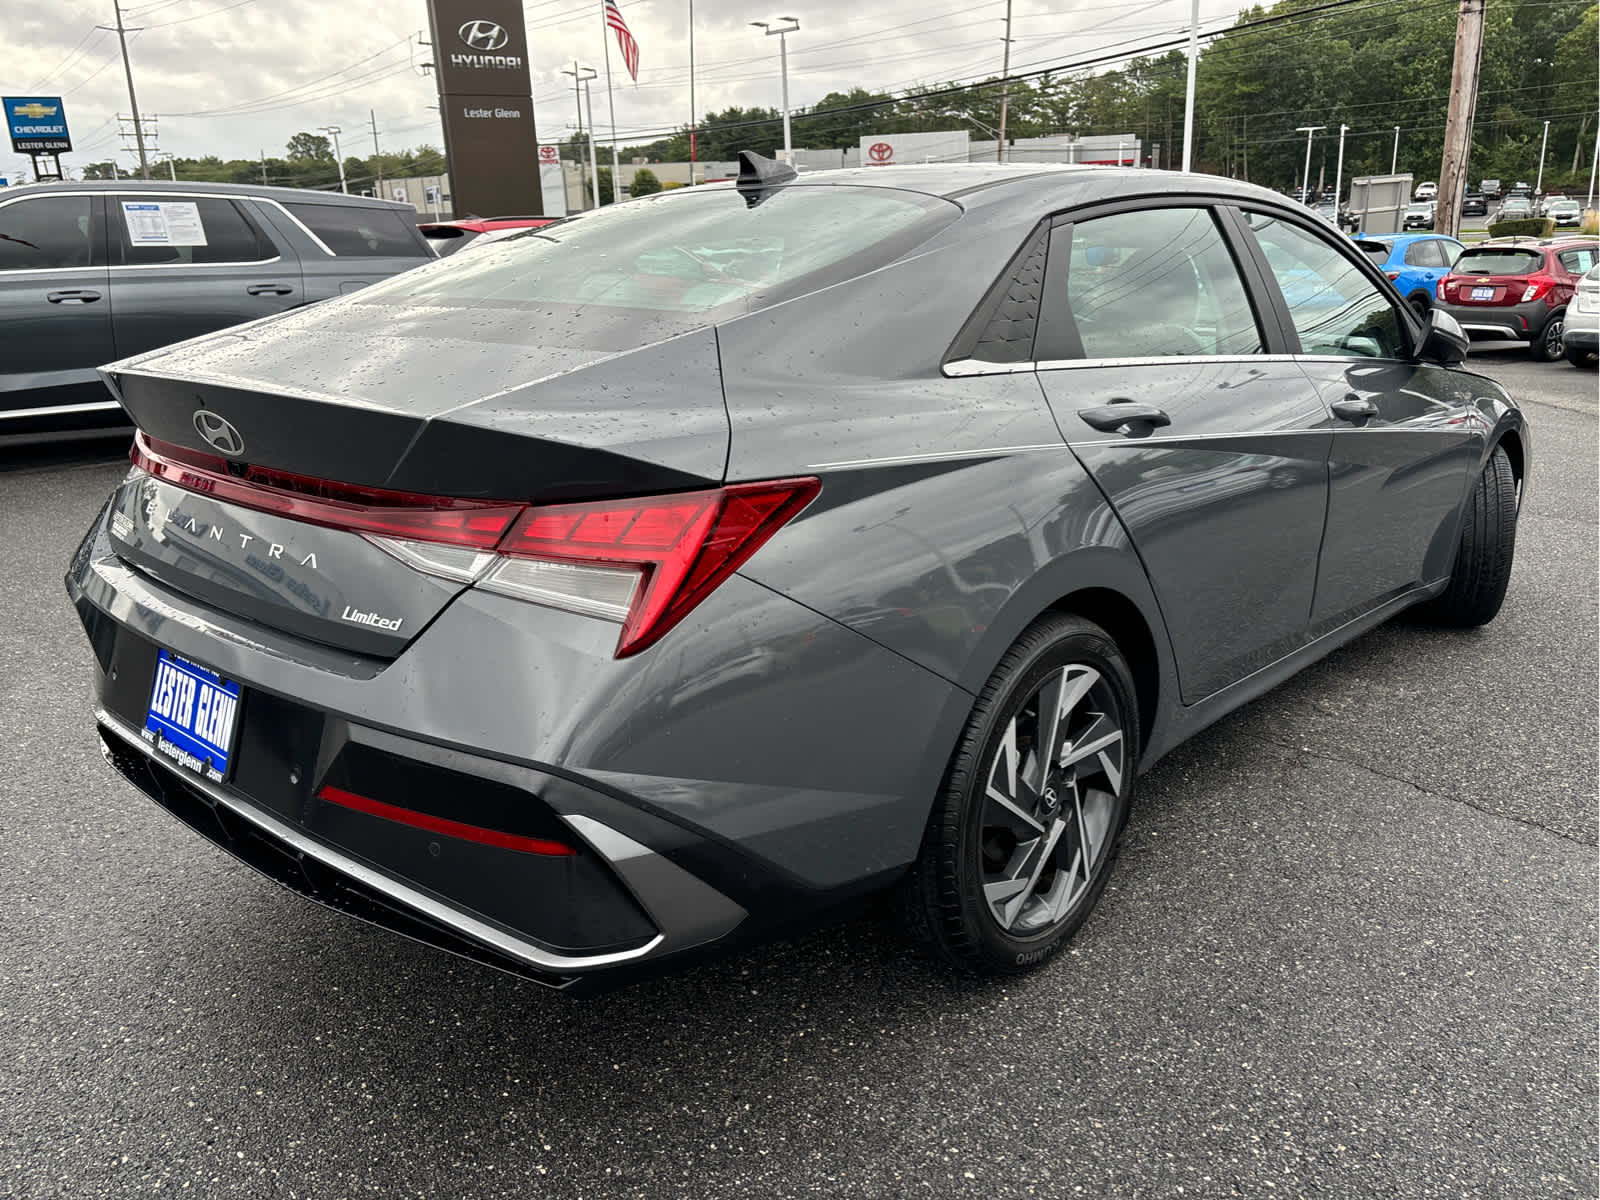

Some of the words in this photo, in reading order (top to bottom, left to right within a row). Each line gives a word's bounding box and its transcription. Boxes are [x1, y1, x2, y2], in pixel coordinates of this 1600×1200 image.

[451, 53, 521, 68] HYUNDAI
[463, 108, 492, 118] Lester
[494, 108, 520, 118] Glenn
[13, 125, 64, 134] CHEVROLET
[17, 142, 44, 150] LESTER
[146, 502, 317, 569] ELANTRA
[341, 606, 402, 631] Limited
[151, 662, 197, 729] LESTER
[195, 683, 237, 752] GLENN
[157, 736, 202, 774] lesterglenn
